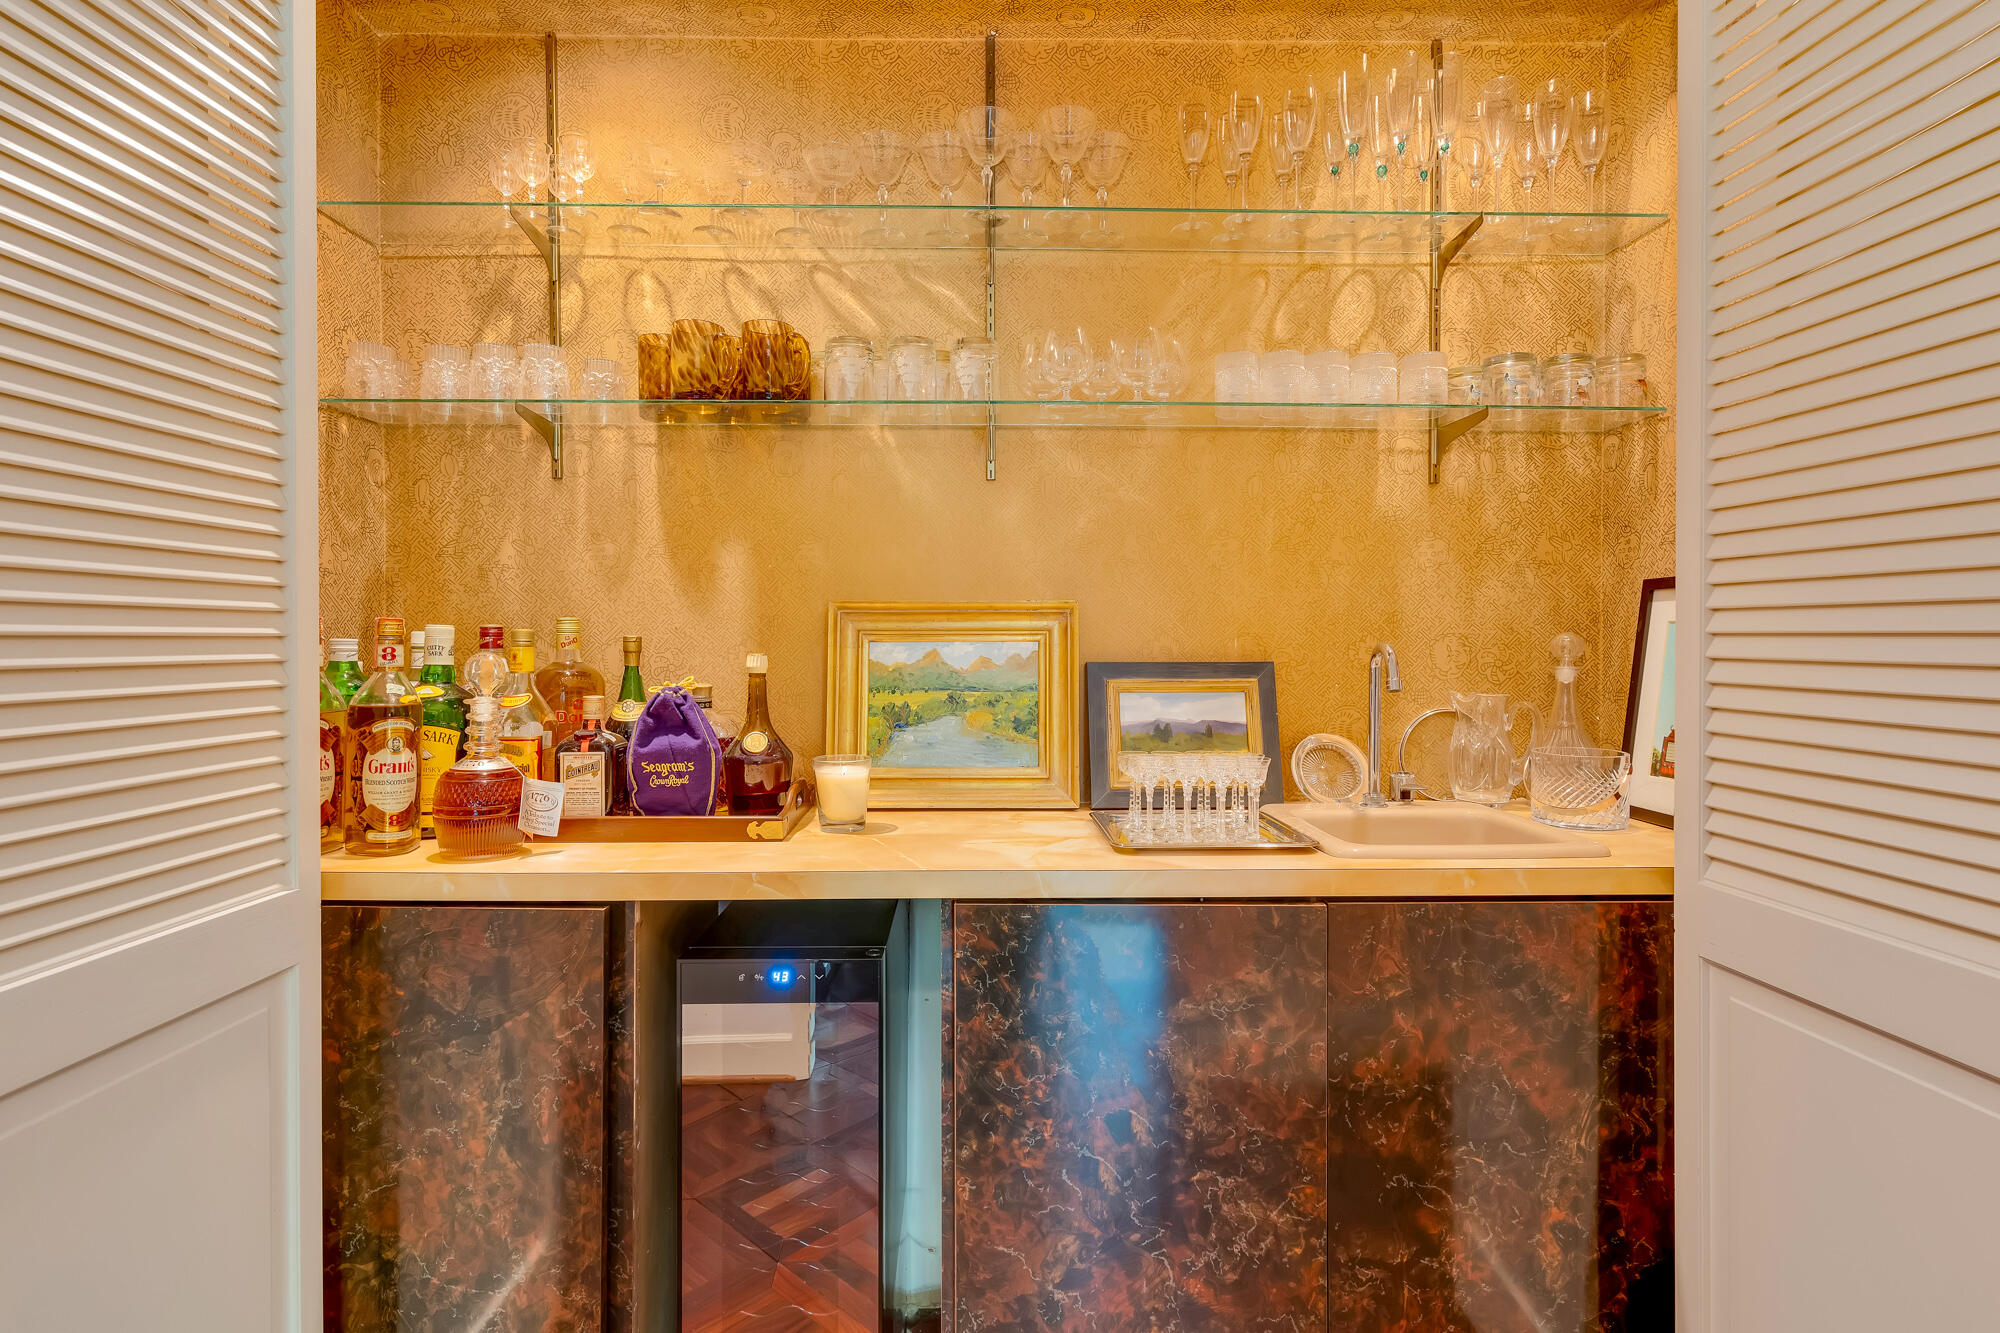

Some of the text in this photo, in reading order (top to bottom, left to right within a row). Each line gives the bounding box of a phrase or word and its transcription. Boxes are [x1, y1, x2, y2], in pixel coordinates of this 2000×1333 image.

[381, 646, 397, 661] 8
[422, 729, 456, 745] SARK
[368, 756, 415, 774] Grant's
[568, 763, 599, 777] COINTREAU
[641, 761, 695, 776] Seagram's
[531, 792, 550, 803] 1776
[389, 814, 400, 827] 8
[773, 971, 789, 982] 43
